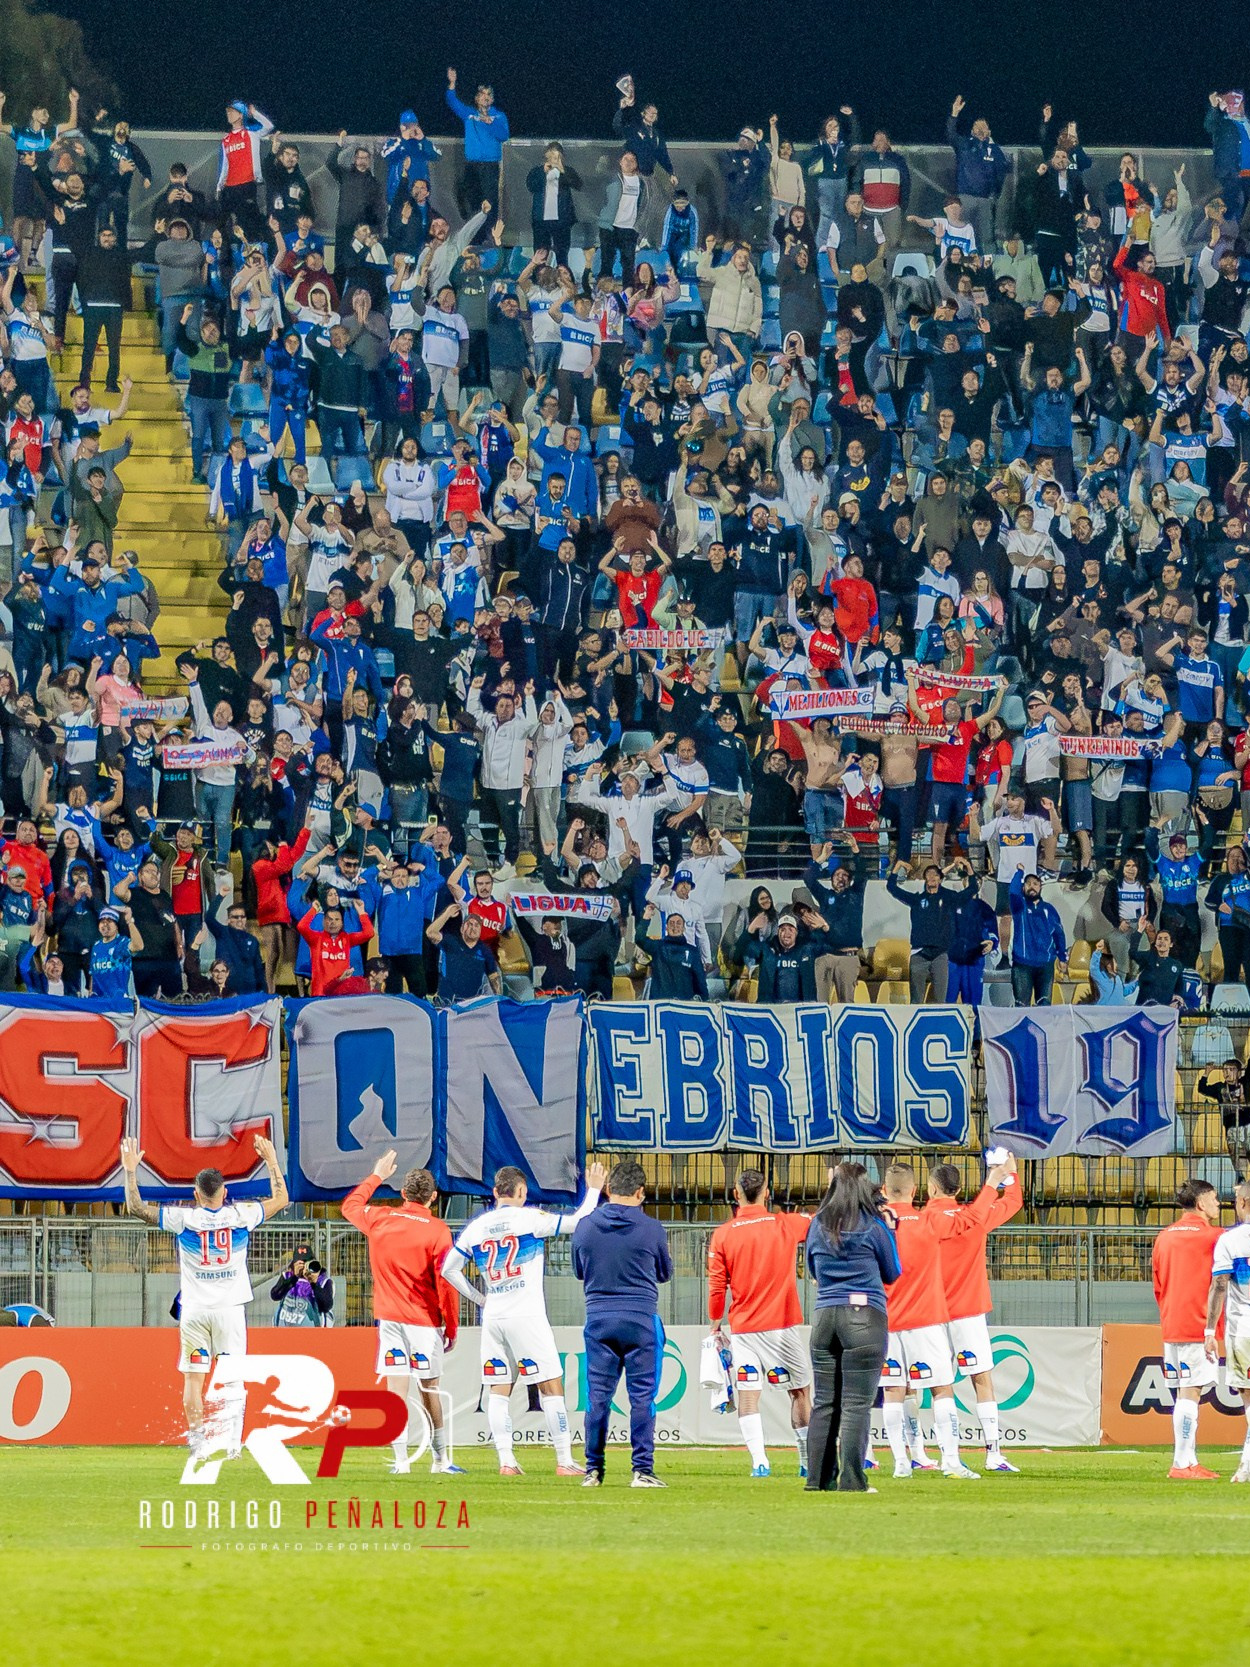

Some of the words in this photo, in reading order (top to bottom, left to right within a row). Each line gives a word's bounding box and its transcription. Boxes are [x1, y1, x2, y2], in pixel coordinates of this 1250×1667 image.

[629, 631, 685, 648] CABILDO
[822, 642, 840, 655] BICE
[789, 690, 858, 712] MEJILLONES
[1232, 884, 1250, 894] BICE
[514, 895, 588, 913] LIGUA
[483, 918, 502, 931] BICE
[782, 960, 797, 968] BIC
[590, 1003, 971, 1150] EBRIOS
[992, 1011, 1176, 1152] 19
[197, 1228, 232, 1266] 19
[480, 1235, 522, 1281] 22
[195, 1271, 238, 1280] SAMSUNG
